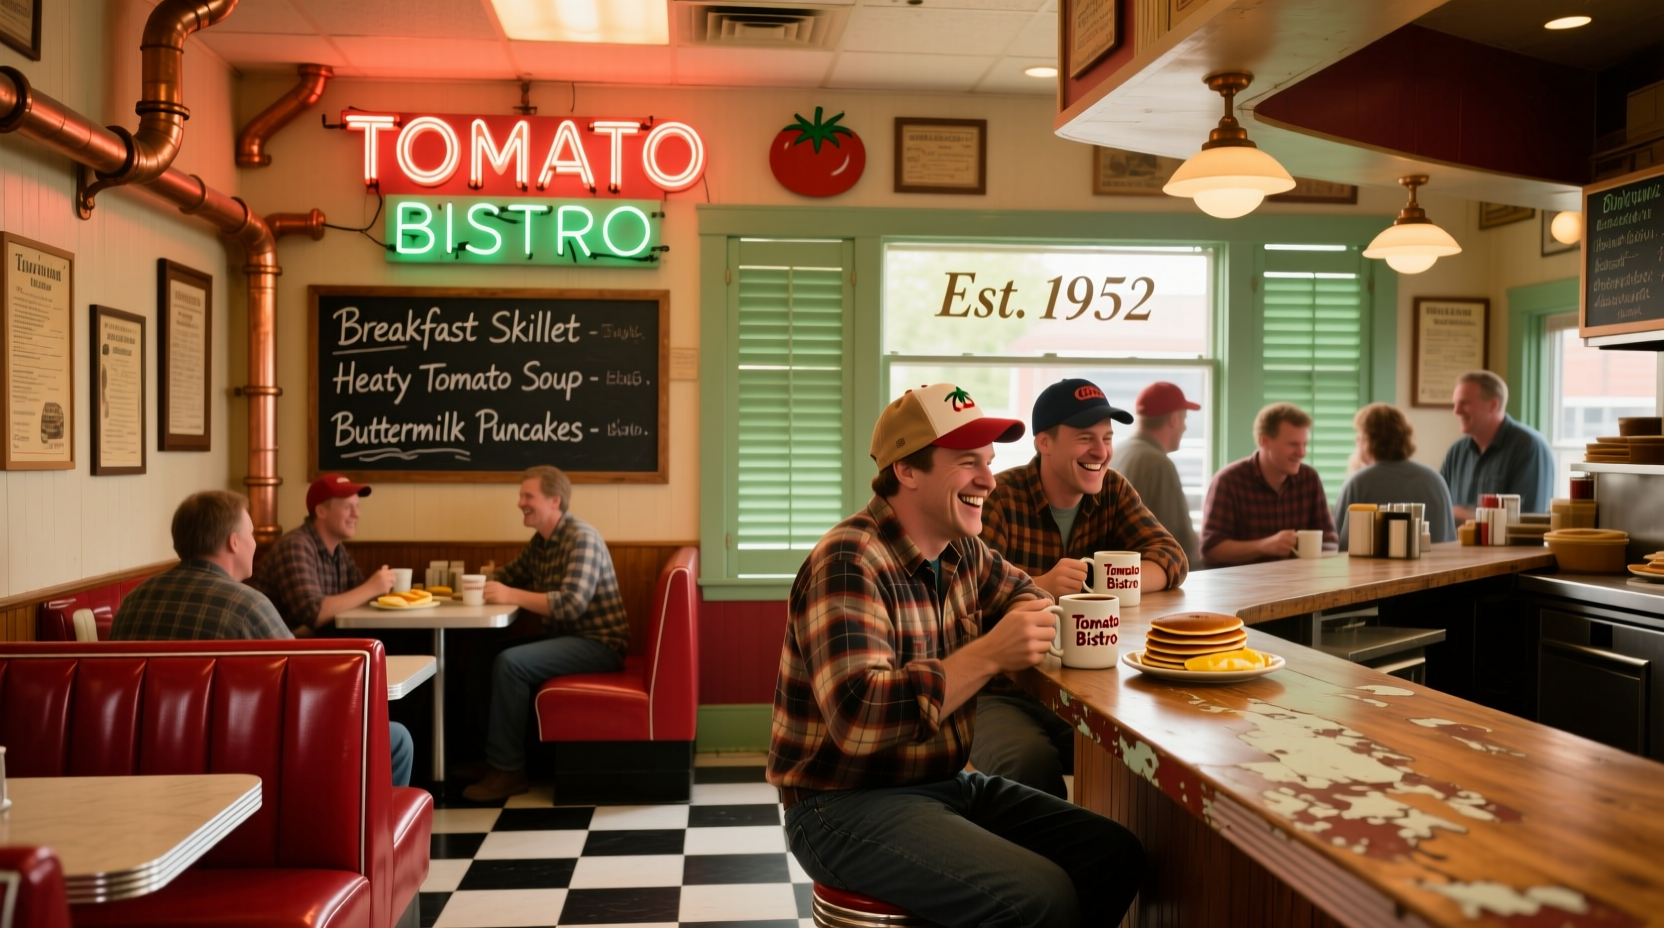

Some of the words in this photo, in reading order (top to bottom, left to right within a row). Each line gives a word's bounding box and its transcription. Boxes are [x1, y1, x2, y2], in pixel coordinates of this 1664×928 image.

[344, 115, 707, 192] TOMATO
[395, 201, 651, 257] BISTRO
[935, 271, 1026, 319] Est.
[1039, 275, 1155, 322] 1952
[332, 306, 479, 351] Breakfast
[489, 309, 581, 344] Skillet
[332, 360, 412, 405] Heaty
[419, 362, 512, 392] Tomato
[521, 360, 583, 401] Soup
[330, 410, 465, 447] Buttermilk
[475, 408, 583, 445] Puncakes
[1072, 614, 1119, 630] Tomato
[1076, 631, 1118, 647] Bistro
